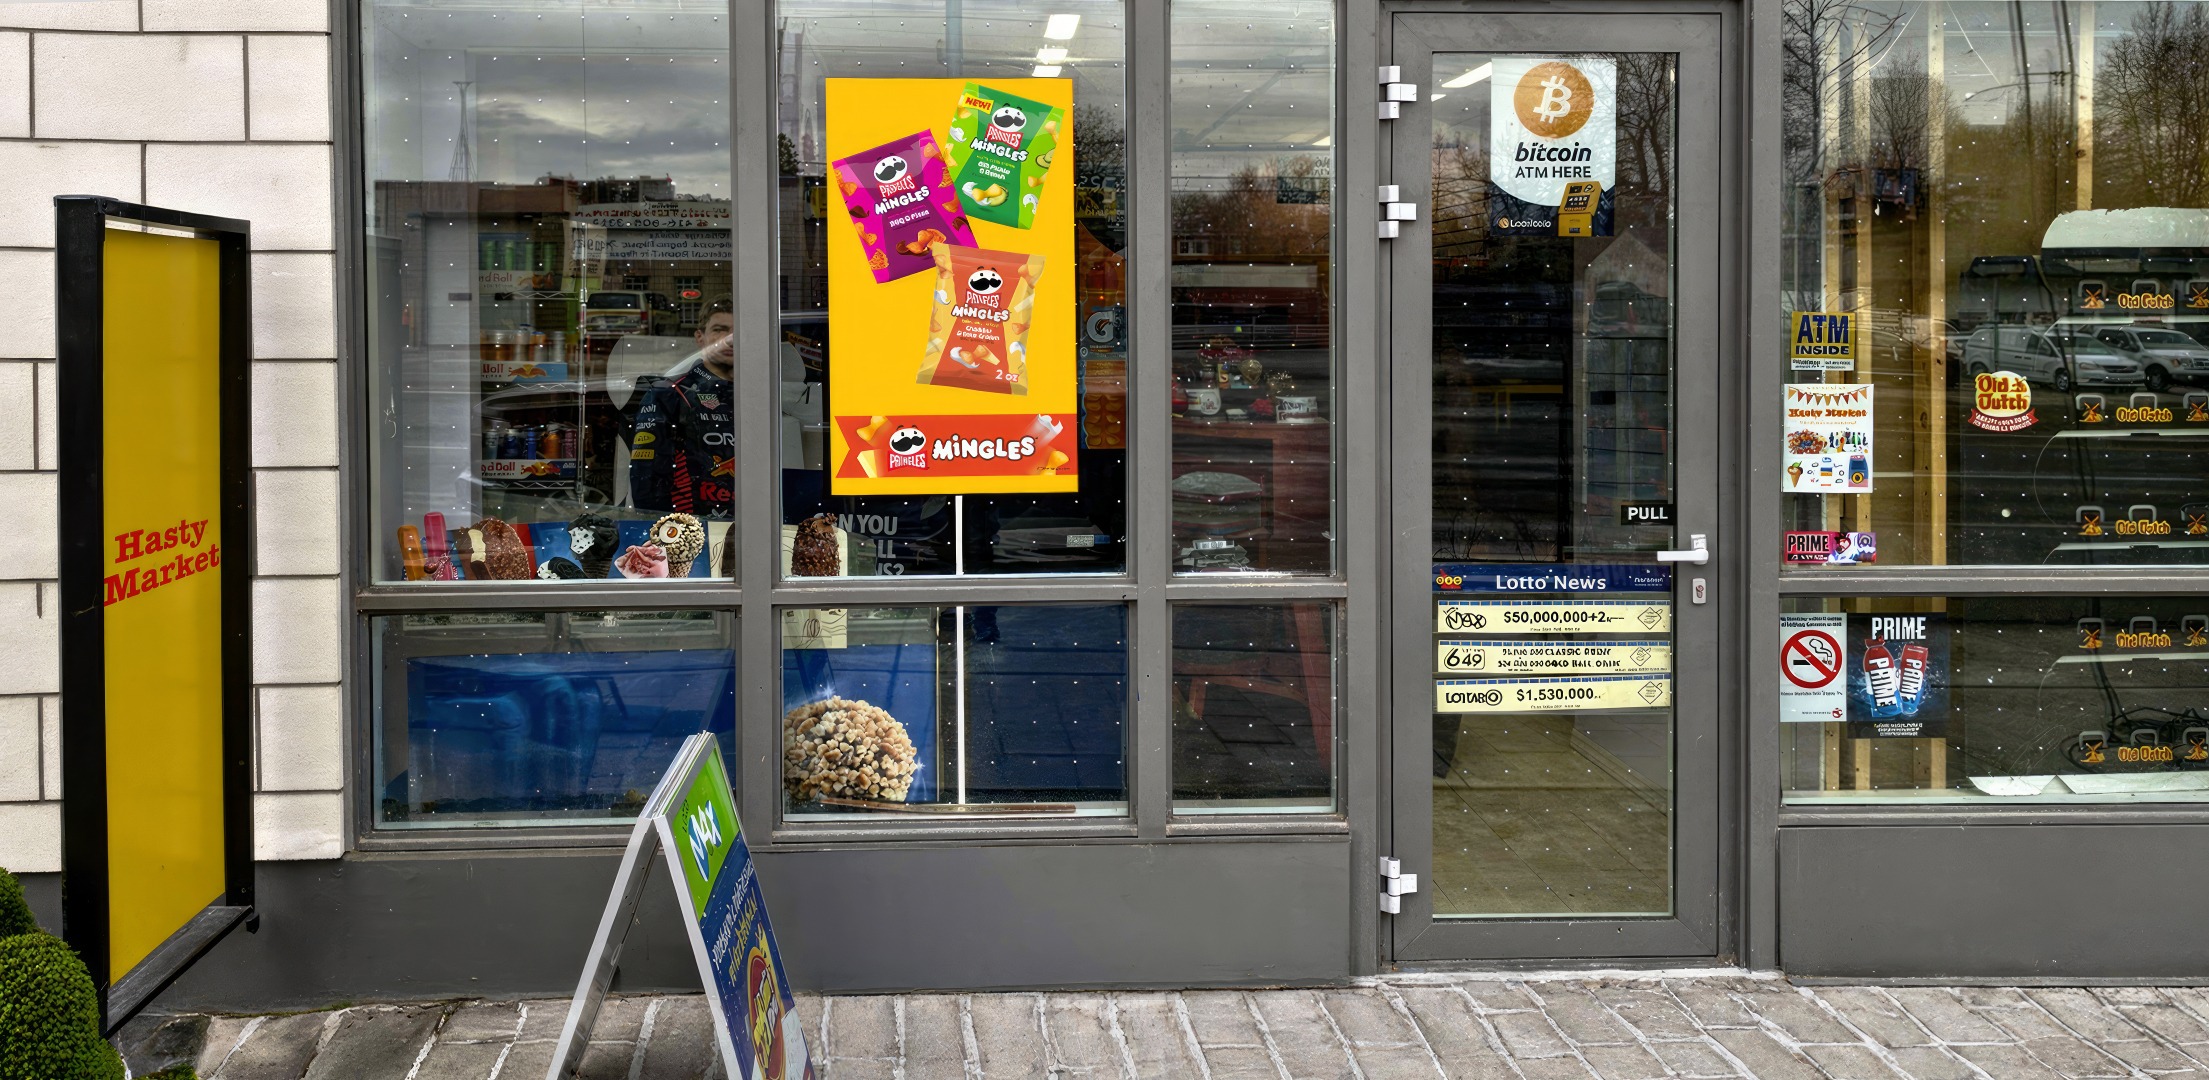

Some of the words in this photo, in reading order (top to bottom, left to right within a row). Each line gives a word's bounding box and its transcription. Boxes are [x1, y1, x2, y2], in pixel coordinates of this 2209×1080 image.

[1515, 142, 1592, 162] bitcoin
[1515, 166, 1548, 178] ATM
[1552, 166, 1592, 178] HERE
[1797, 315, 1849, 343] ATM
[1796, 345, 1849, 355] INSIDE
[995, 370, 1003, 379] 2
[1628, 507, 1668, 521] PULL
[856, 515, 898, 535] YOU
[115, 519, 208, 564] Hasty
[1788, 534, 1829, 552] PRIME
[104, 543, 220, 607] Market
[1496, 575, 1547, 590] Lotto
[1554, 575, 1607, 590] News
[1872, 617, 1926, 640] PRIME
[1869, 657, 1897, 707] PRIME
[689, 800, 722, 882] MAX
